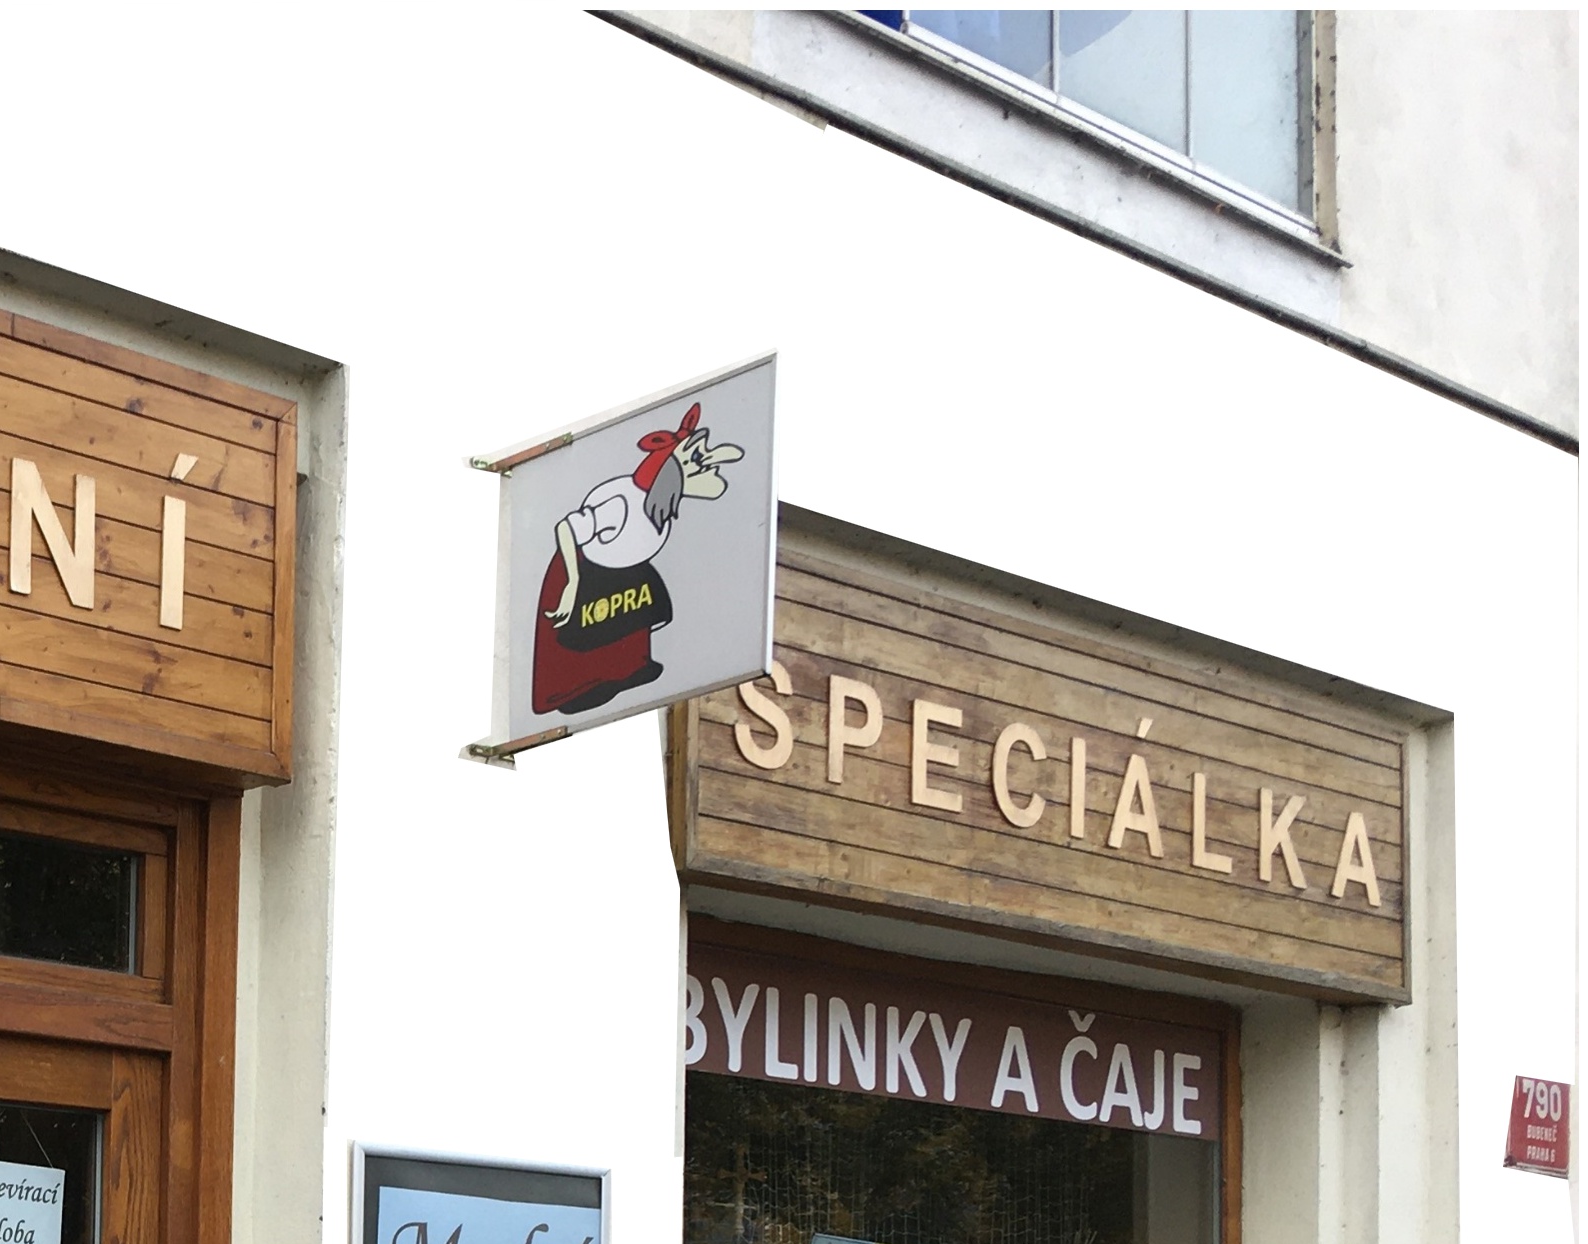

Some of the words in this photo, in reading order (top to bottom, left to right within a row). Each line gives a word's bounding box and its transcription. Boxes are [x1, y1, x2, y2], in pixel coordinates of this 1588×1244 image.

[580, 583, 652, 628] KOPRA
[732, 656, 1382, 907] SPECIÁLKA
[685, 974, 972, 1104] BYLINKY
[990, 1026, 1040, 1115] A
[1058, 1010, 1203, 1137] ČAJE
[1522, 1078, 1562, 1122] 790
[1526, 1145, 1549, 1162] PRAHA
